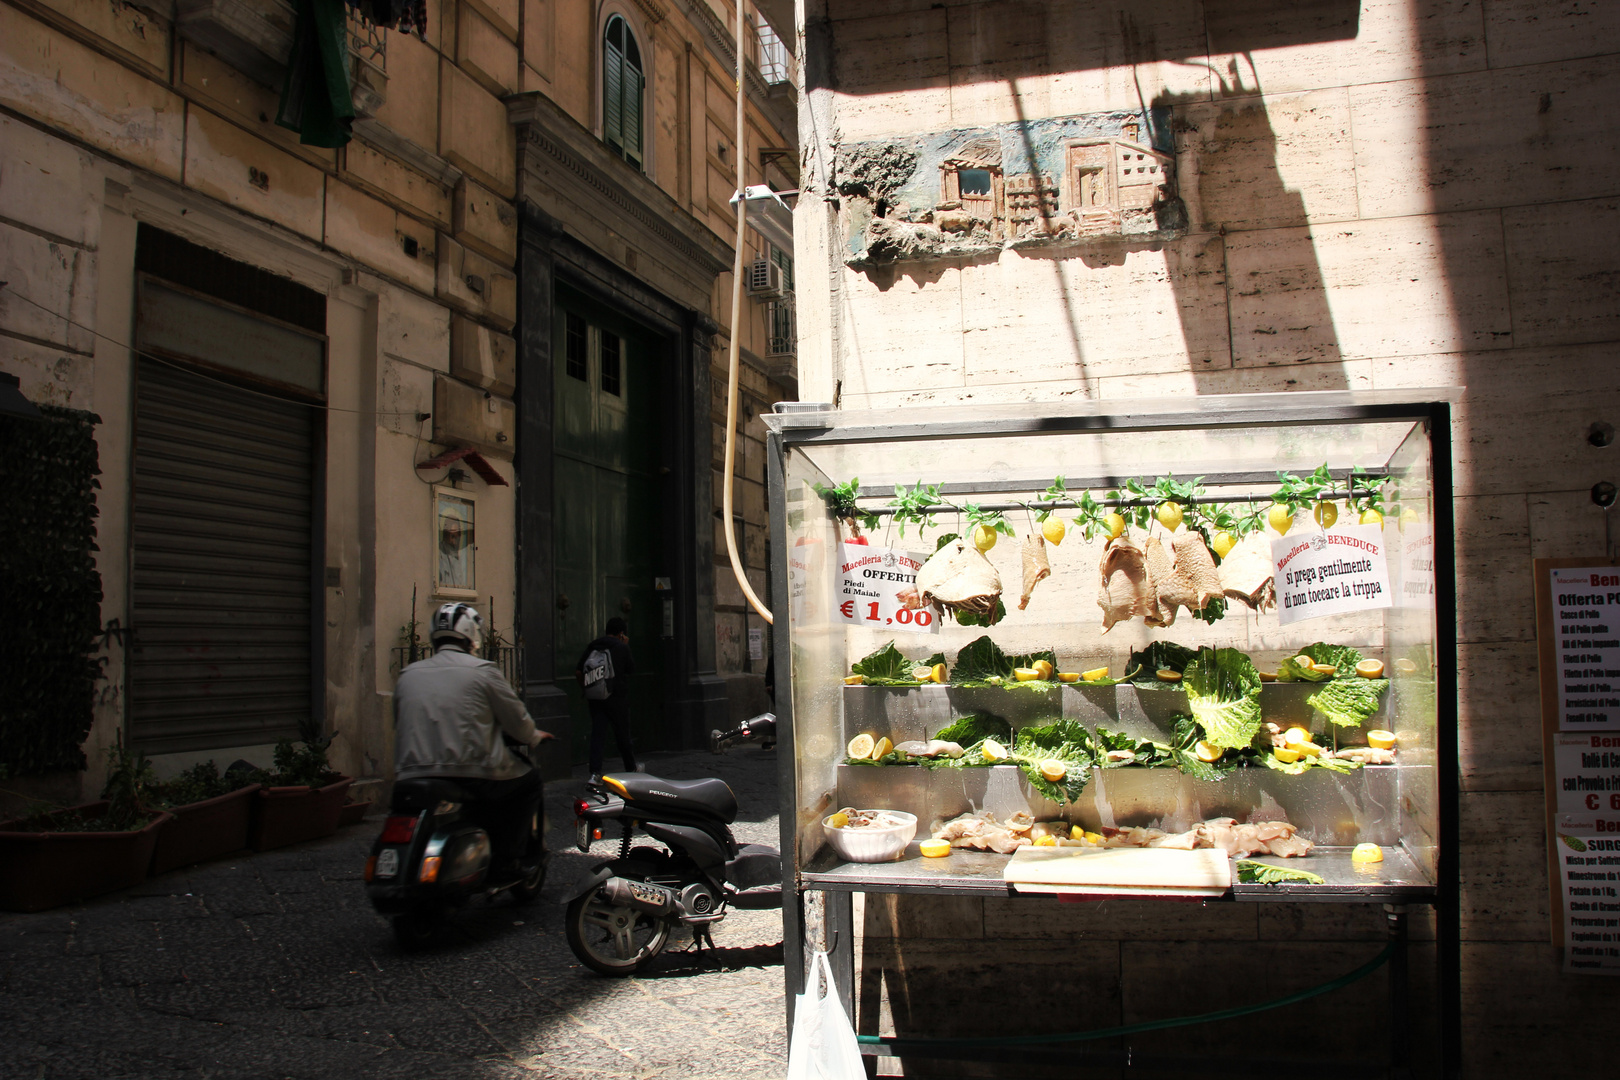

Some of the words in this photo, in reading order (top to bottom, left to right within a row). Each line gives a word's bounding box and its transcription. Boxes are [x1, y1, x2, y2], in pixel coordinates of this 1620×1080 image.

[1277, 541, 1310, 572] Macelleria
[1328, 535, 1379, 556] BENEDUCE
[842, 554, 882, 574] Macelleria
[899, 556, 923, 572] BENE
[1286, 568, 1293, 585] si
[1294, 567, 1317, 588] prega
[1318, 556, 1372, 583] gentilmente
[844, 580, 865, 588] Piedi
[843, 587, 851, 595] di
[853, 588, 880, 598] Maiale
[1284, 592, 1291, 609] di
[1292, 594, 1307, 607] non
[1308, 587, 1340, 603] toccare
[1341, 581, 1350, 598] la
[1352, 579, 1382, 600] trippa
[1558, 593, 1604, 606] Offerta
[840, 600, 854, 618] €
[866, 601, 932, 627] 1,00
[1578, 610, 1584, 619] di
[1585, 610, 1600, 619] Pollo
[1570, 625, 1576, 634] di
[1576, 624, 1590, 634] Pollo
[1571, 639, 1576, 648] di
[1577, 639, 1592, 648] Pollo
[1580, 654, 1586, 663] di
[1587, 654, 1602, 663] Pollo
[584, 665, 605, 687] NIKE
[1583, 669, 1588, 678] di
[1589, 668, 1604, 678] Pollo
[1589, 683, 1595, 693] di
[1596, 683, 1611, 693] Pollo
[1598, 698, 1604, 707] di
[1605, 698, 1620, 707] Pollo
[1586, 713, 1591, 722] di
[1592, 713, 1607, 722] Pollo
[1601, 752, 1609, 768] di
[1563, 777, 1577, 791] con
[1577, 775, 1605, 791] Provola
[1605, 777, 1611, 791] e
[649, 789, 678, 799] PEUGEOT
[1585, 793, 1600, 811] €
[1565, 856, 1585, 865] Misto
[1585, 857, 1597, 866] per
[1567, 871, 1607, 881] Minestrone
[1607, 871, 1616, 880] da
[1569, 886, 1591, 896] Patate
[1592, 886, 1601, 896] da
[1570, 901, 1590, 911] Chele
[1591, 902, 1598, 911] di
[1571, 917, 1605, 927] Preparato
[1606, 918, 1618, 928] per
[1571, 931, 1601, 942] Fagiolini
[1602, 932, 1611, 942] da
[1571, 946, 1593, 956] Piselli
[1594, 947, 1604, 956] da
